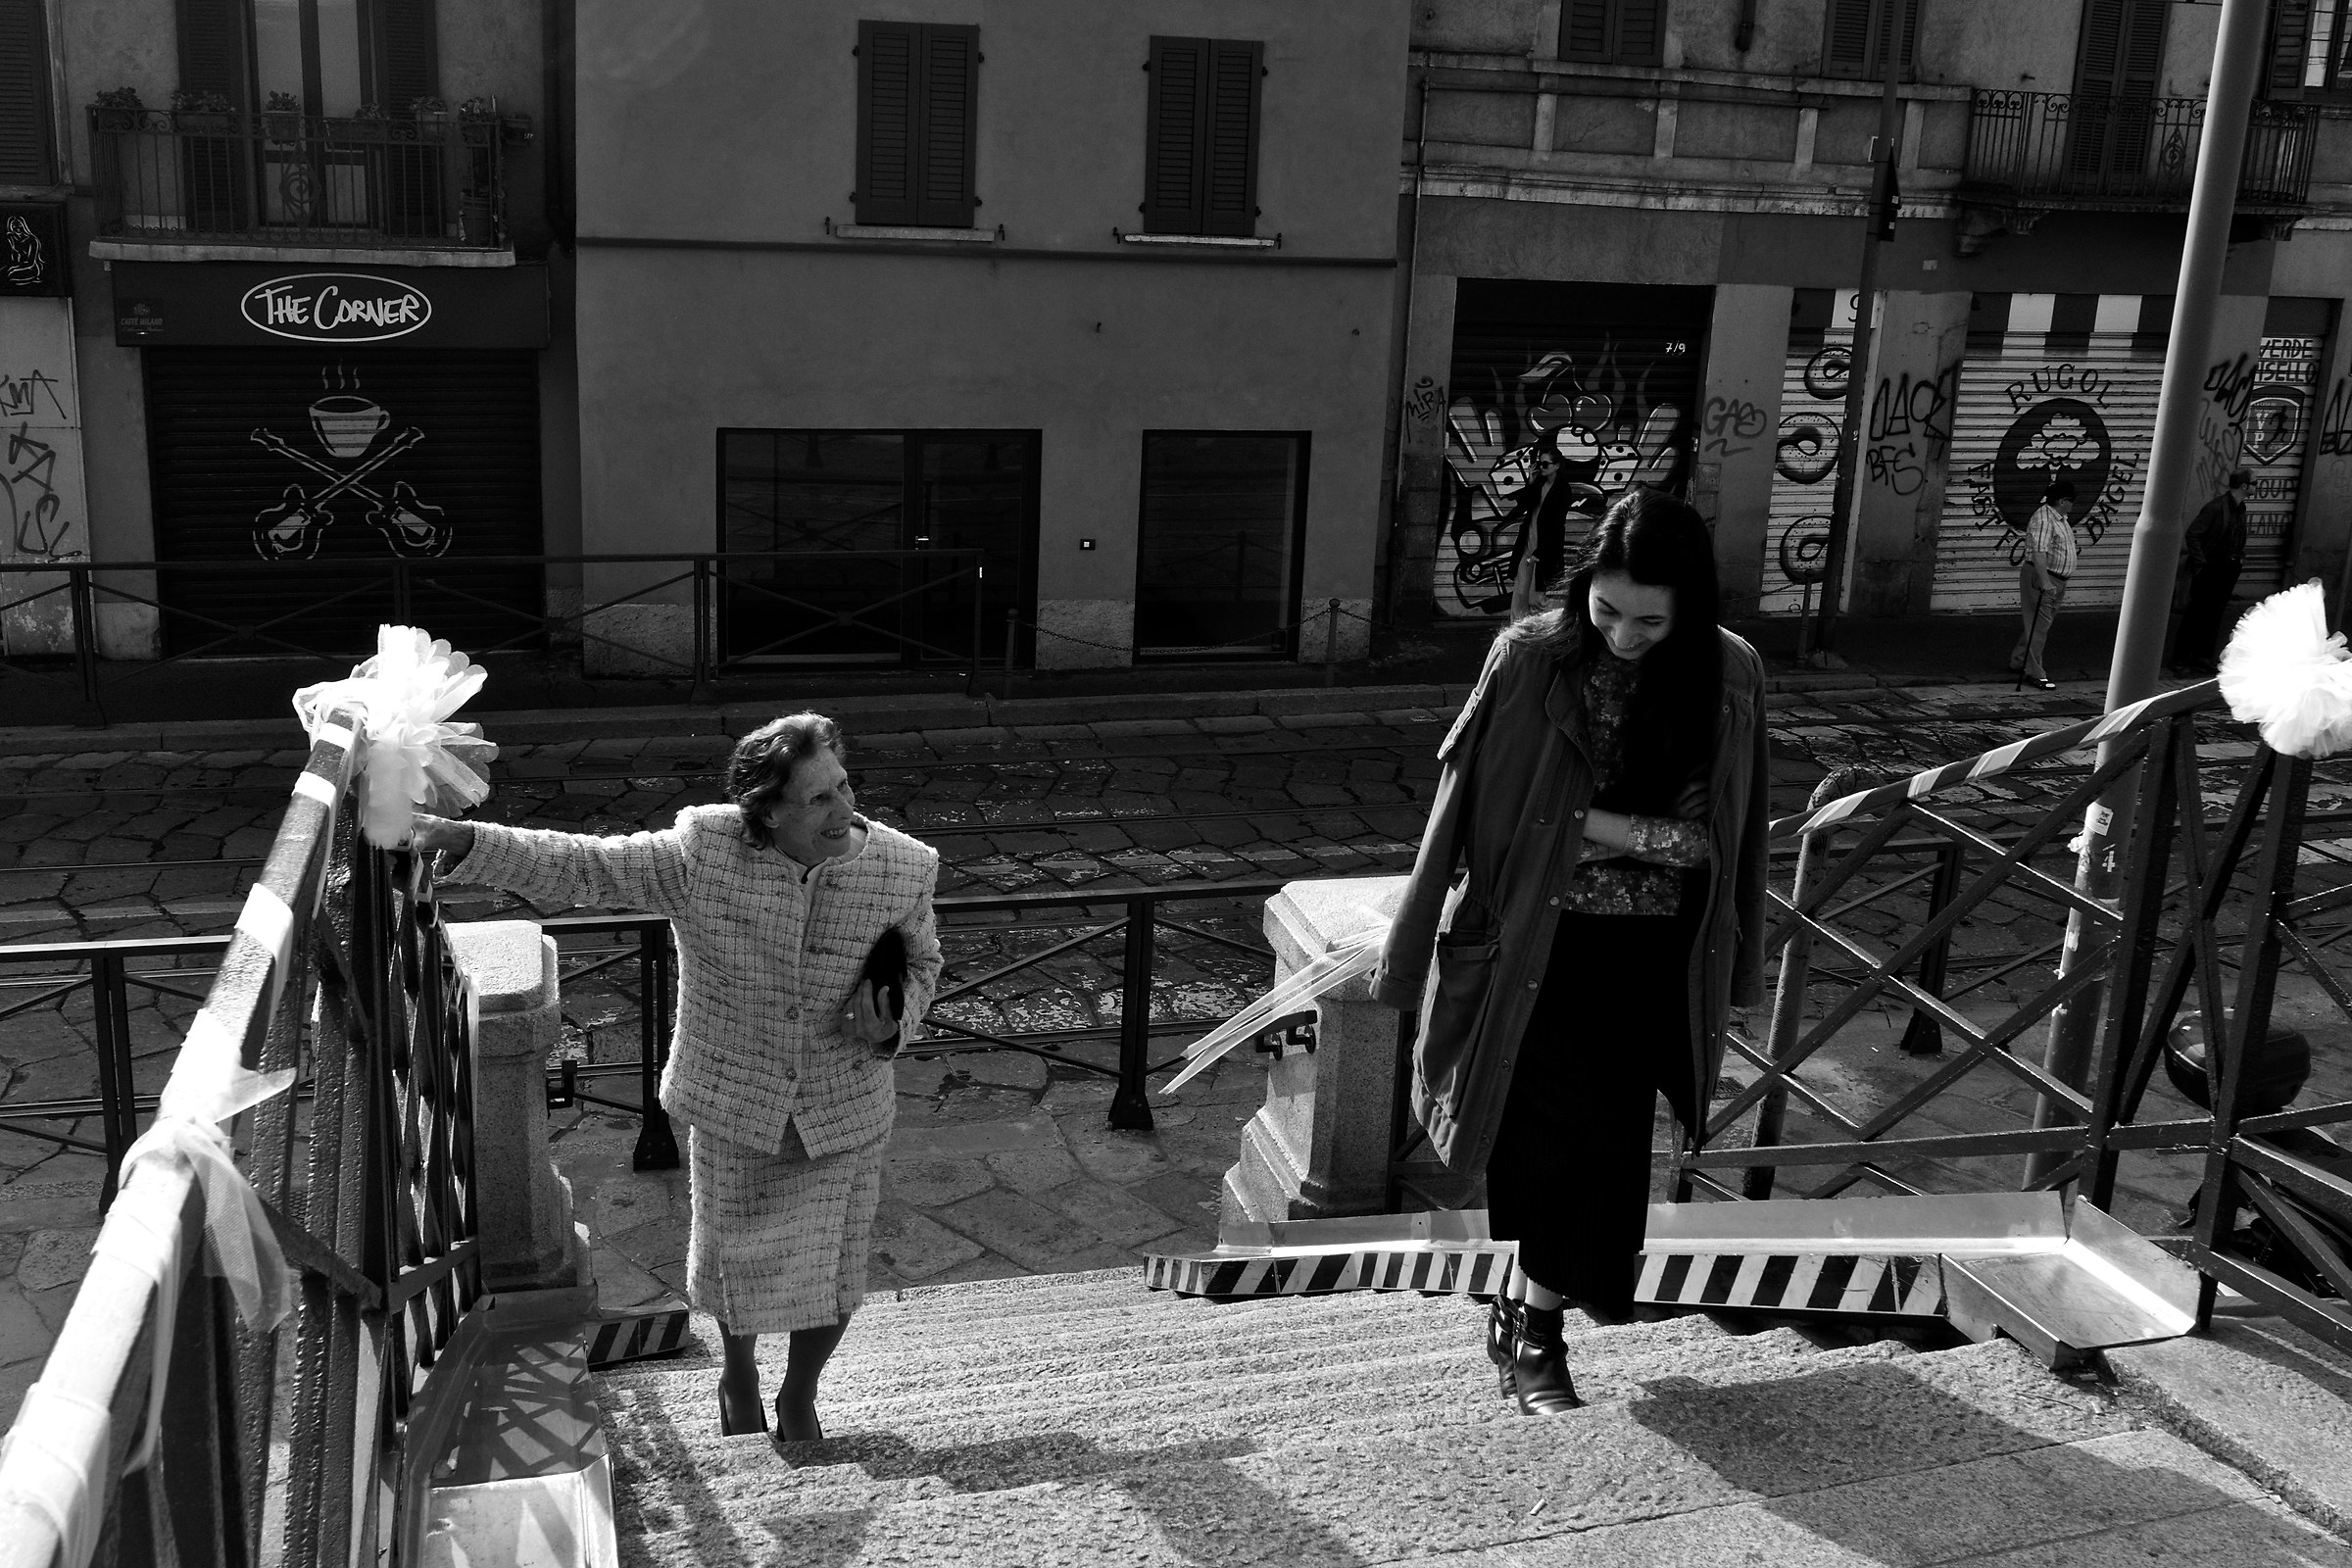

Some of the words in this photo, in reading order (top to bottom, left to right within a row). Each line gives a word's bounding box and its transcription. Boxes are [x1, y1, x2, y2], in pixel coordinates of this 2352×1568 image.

[1665, 341, 1687, 355] 7/9
[2258, 362, 2317, 382] ISELLO
[2086, 453, 2140, 545] BAGEL
